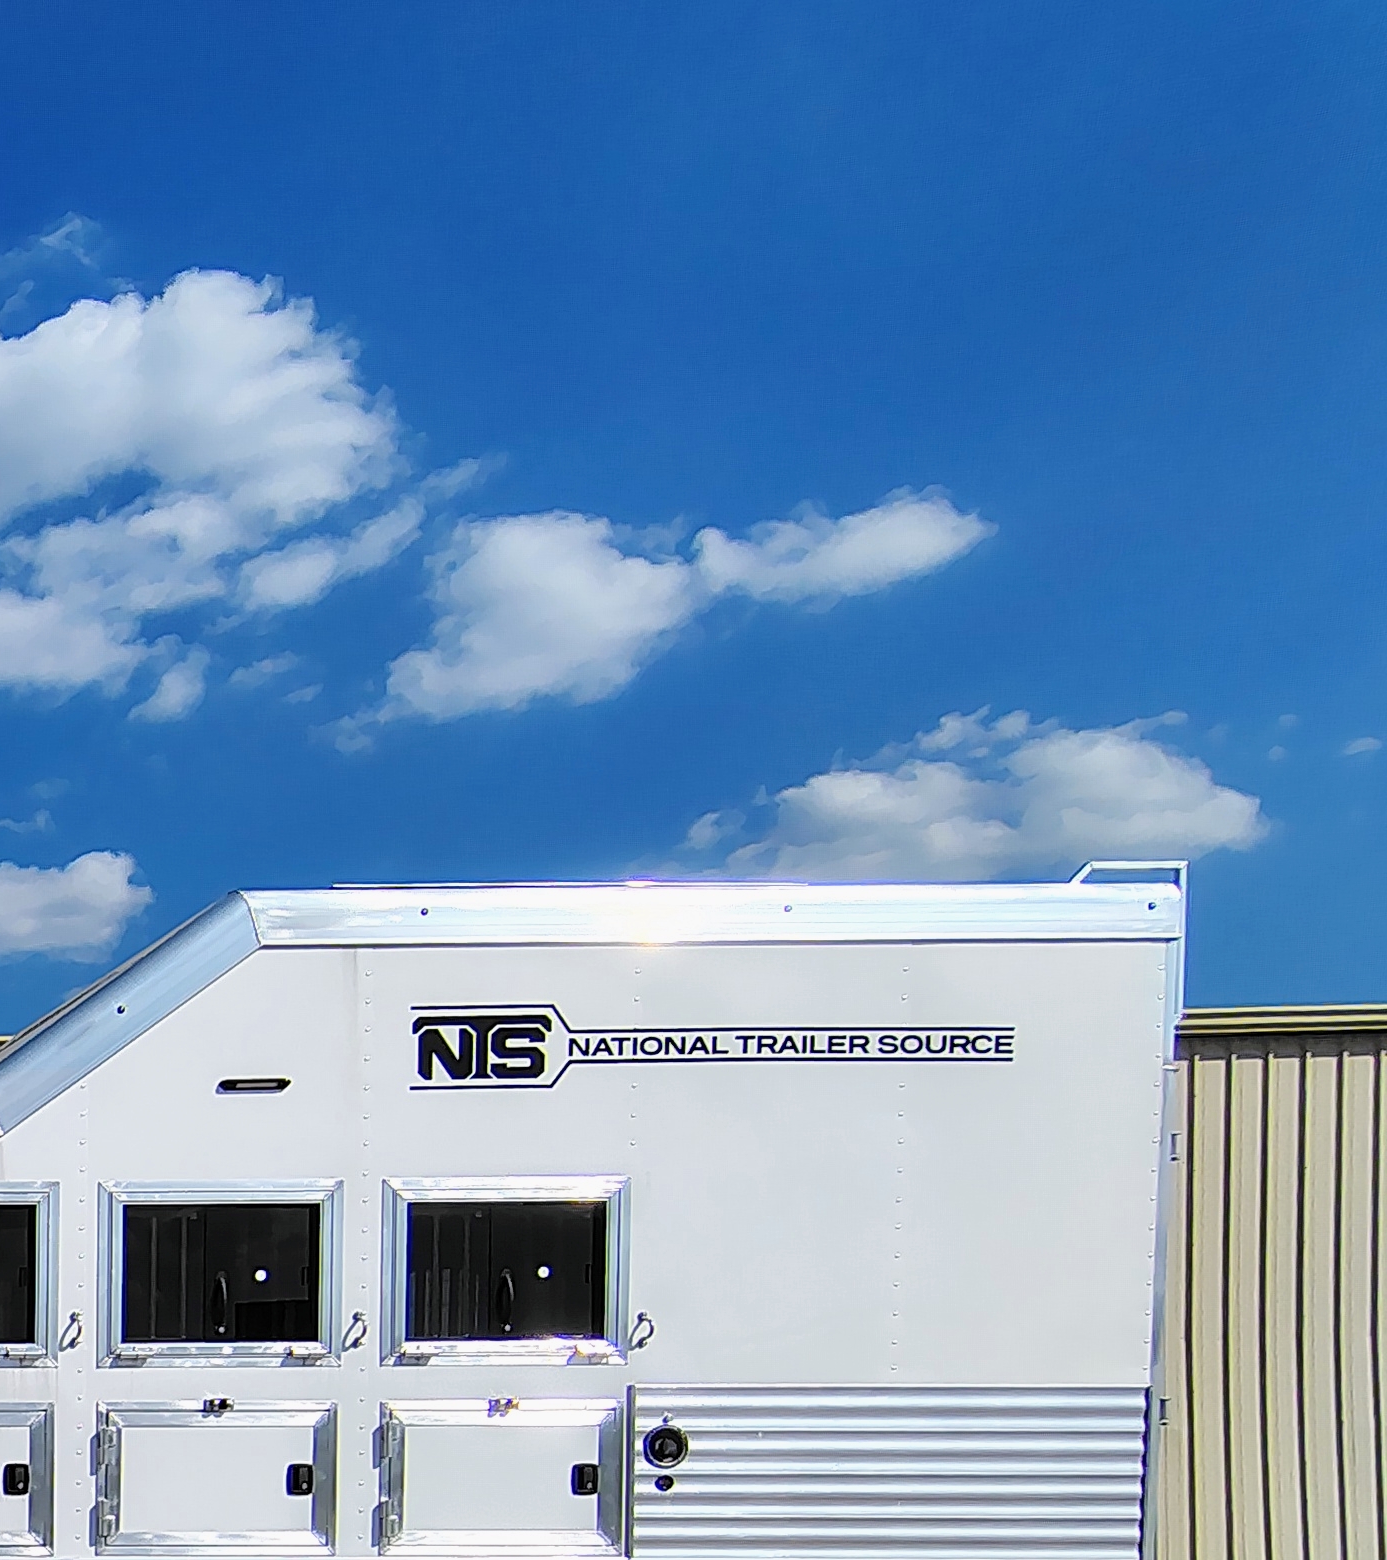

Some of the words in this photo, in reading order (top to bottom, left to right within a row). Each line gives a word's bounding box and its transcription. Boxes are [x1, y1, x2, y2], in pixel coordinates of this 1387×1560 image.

[412, 1014, 552, 1080] NTS
[568, 1036, 729, 1057] NATIONAL
[735, 1035, 870, 1055] TRAILER
[877, 1034, 1015, 1055] SOURCE
